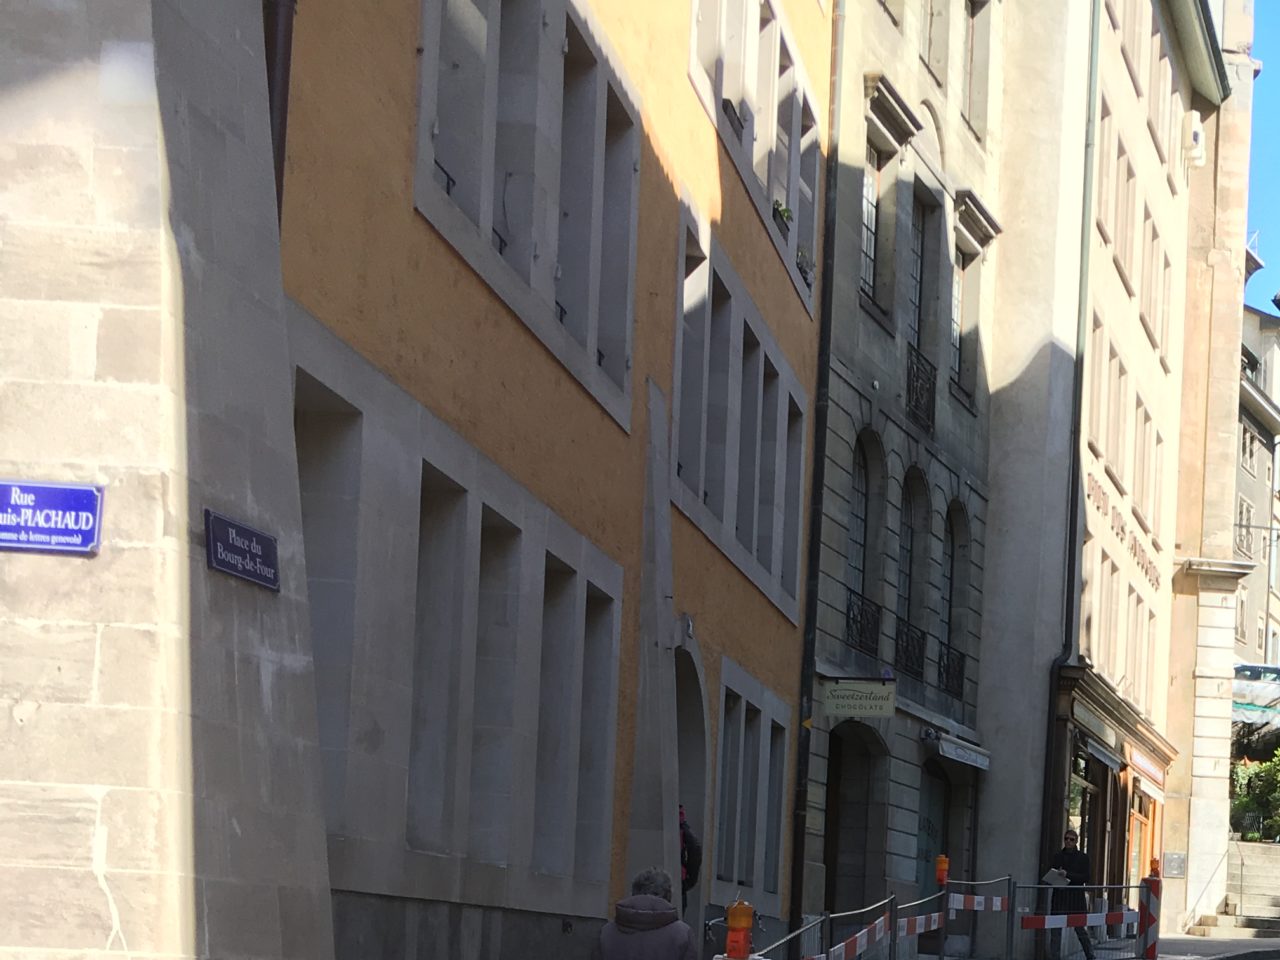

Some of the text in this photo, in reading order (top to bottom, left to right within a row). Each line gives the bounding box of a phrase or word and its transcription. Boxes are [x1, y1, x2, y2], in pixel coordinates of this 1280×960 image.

[10, 486, 35, 506] Rue
[228, 528, 262, 555] Place du
[217, 542, 275, 579] Bourg-de-Four
